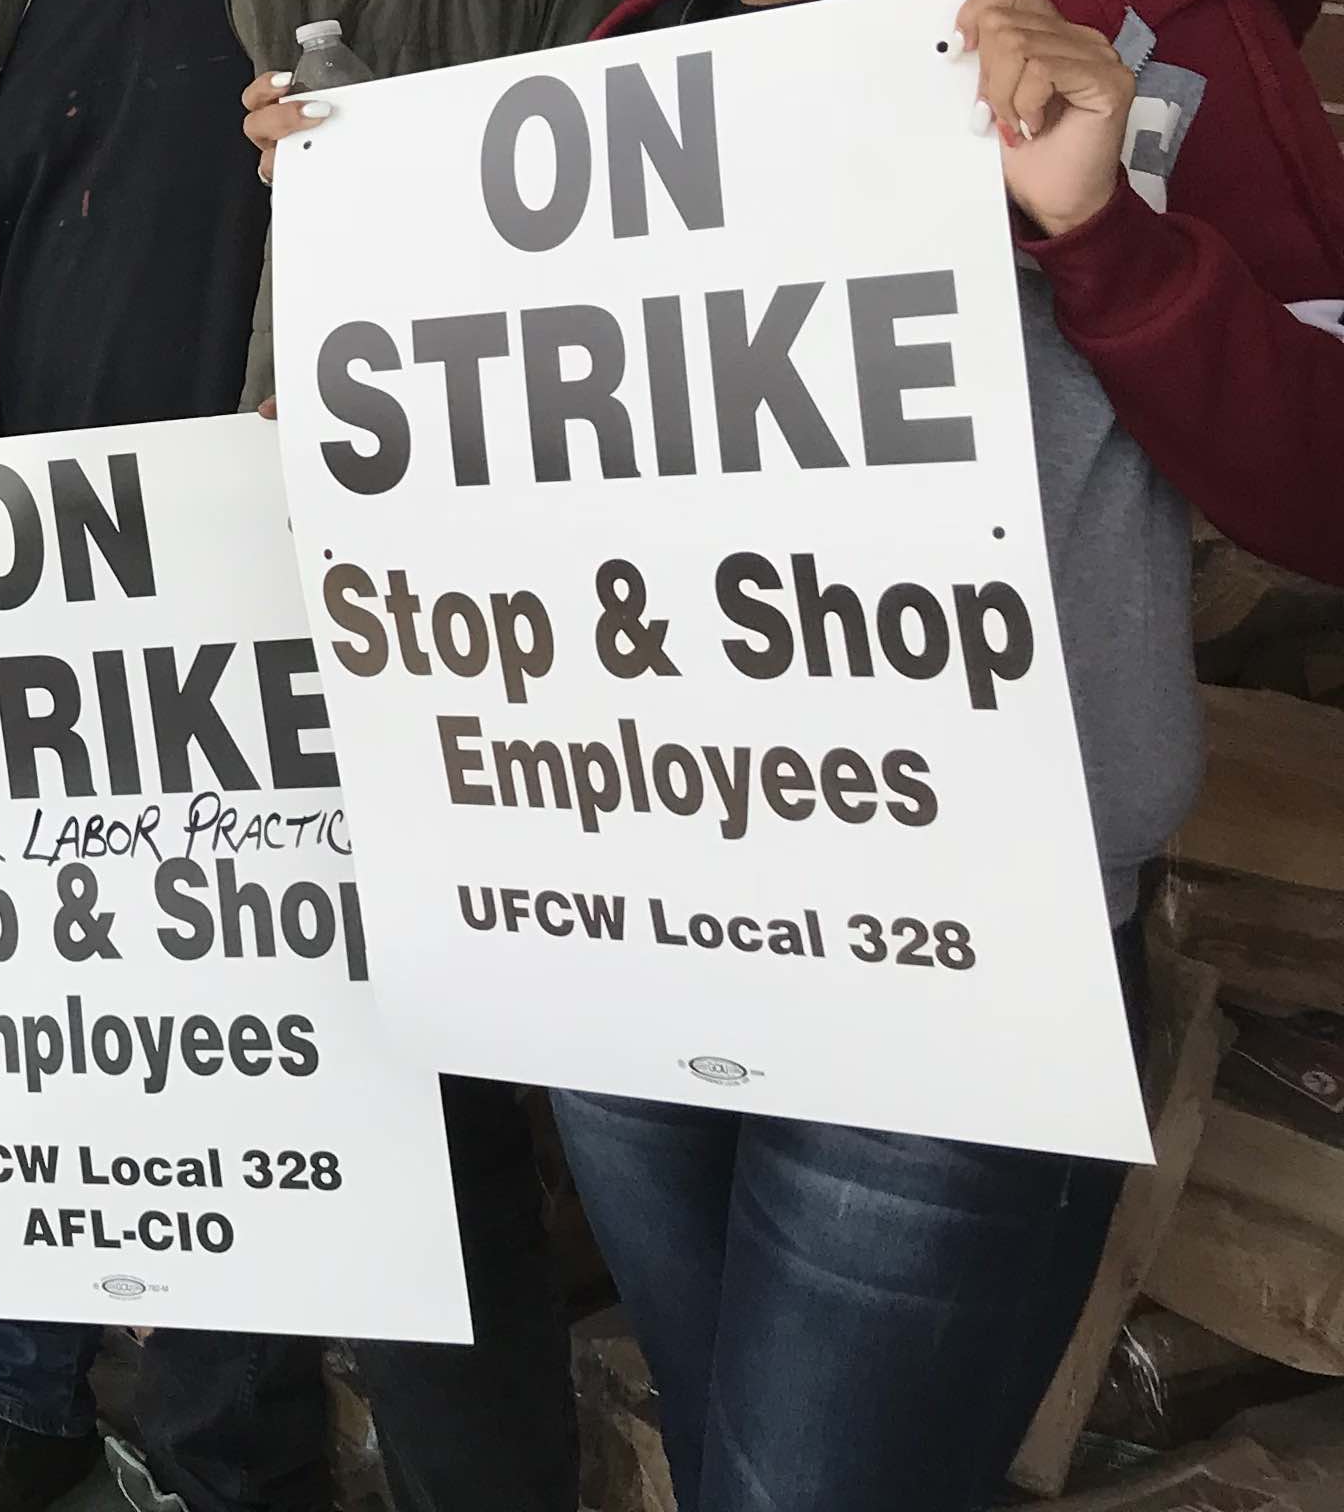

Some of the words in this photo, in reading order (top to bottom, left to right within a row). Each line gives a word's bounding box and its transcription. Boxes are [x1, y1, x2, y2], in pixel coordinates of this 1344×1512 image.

[481, 51, 724, 252] ON
[317, 270, 976, 495] STRIKE
[323, 564, 554, 703] Stop
[596, 559, 682, 679] &
[716, 552, 1033, 710] Shop
[437, 716, 938, 839] Employees
[24, 804, 164, 863] LABOR
[186, 794, 353, 857] PRACTIC
[53, 863, 123, 964] &
[458, 886, 624, 940] UFCW
[649, 899, 825, 957] Local
[848, 914, 975, 970] 328
[79, 1147, 222, 1187] Local
[243, 1150, 342, 1190] 328
[24, 1209, 234, 1255] AFL-CIO
